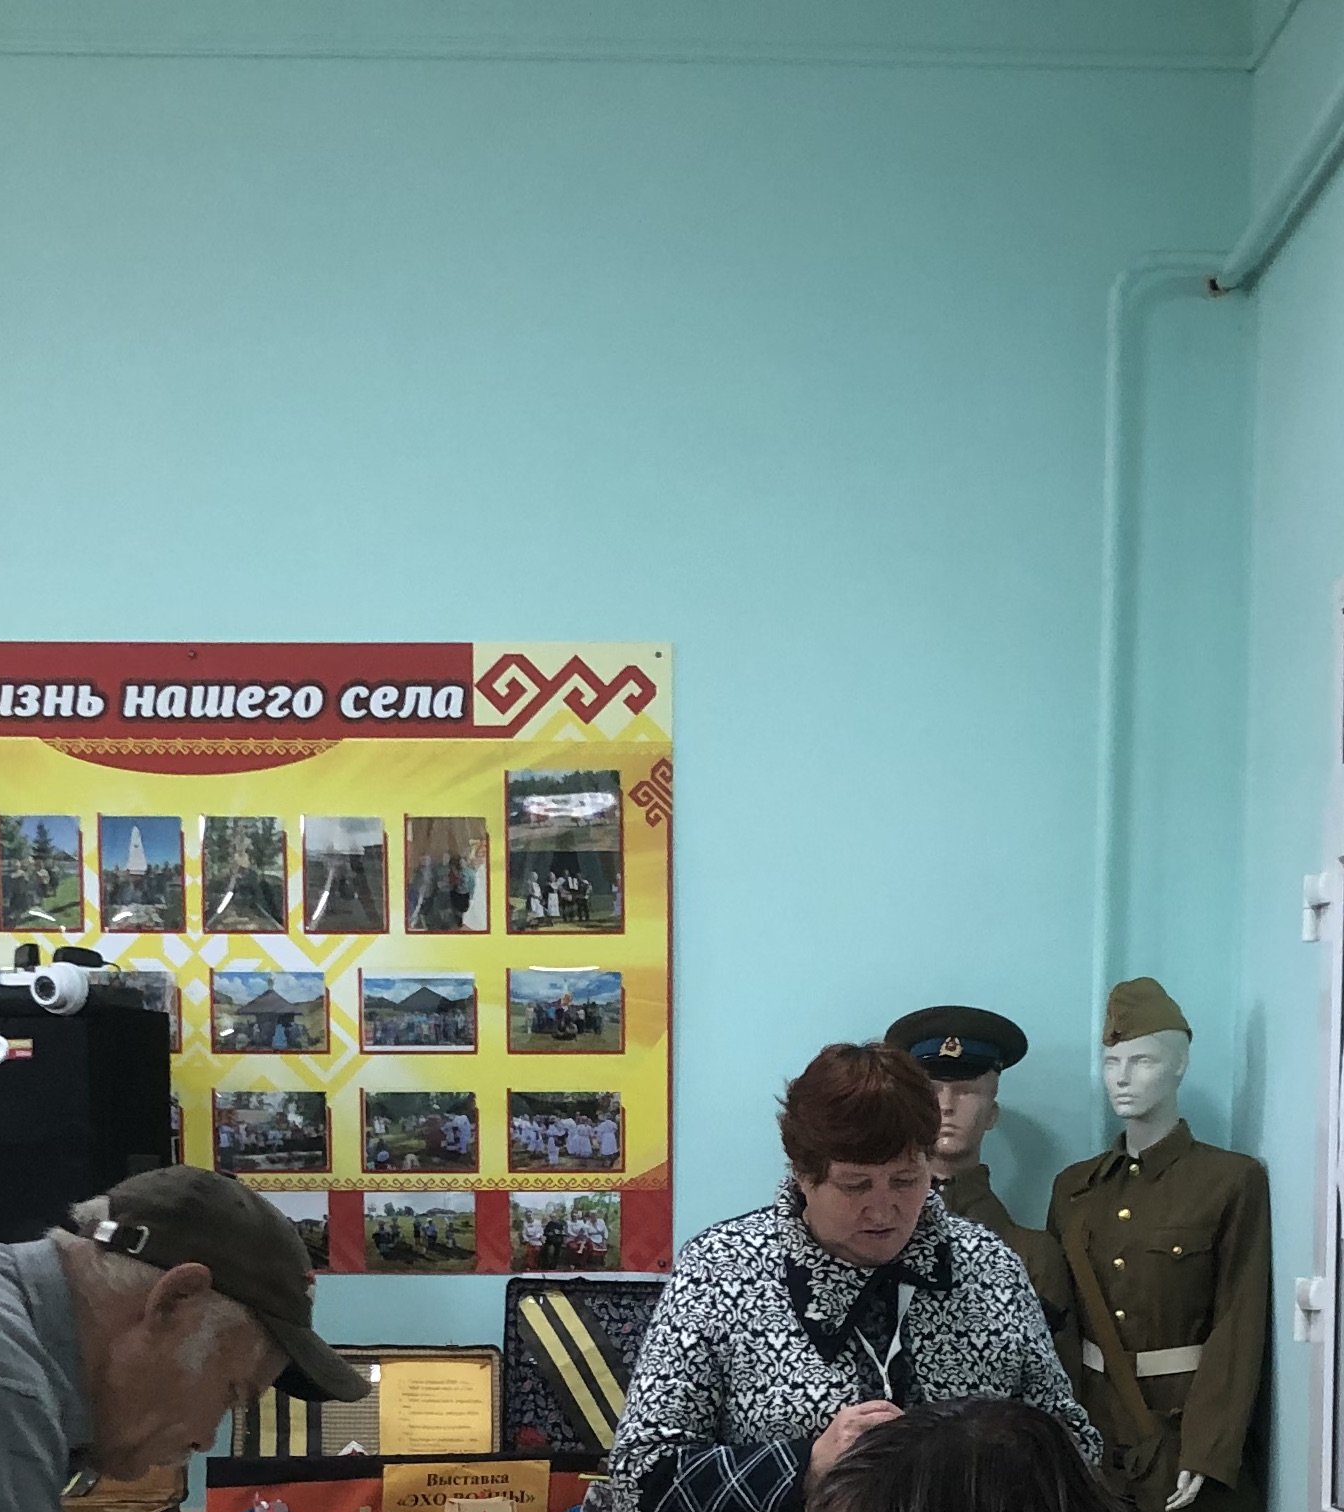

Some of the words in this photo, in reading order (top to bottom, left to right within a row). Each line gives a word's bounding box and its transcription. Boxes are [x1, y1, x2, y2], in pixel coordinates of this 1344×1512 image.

[123, 683, 323, 719] нашего
[340, 683, 465, 719] села
[426, 1472, 510, 1487] Выставка
[397, 1492, 447, 1508] «ЭХО
